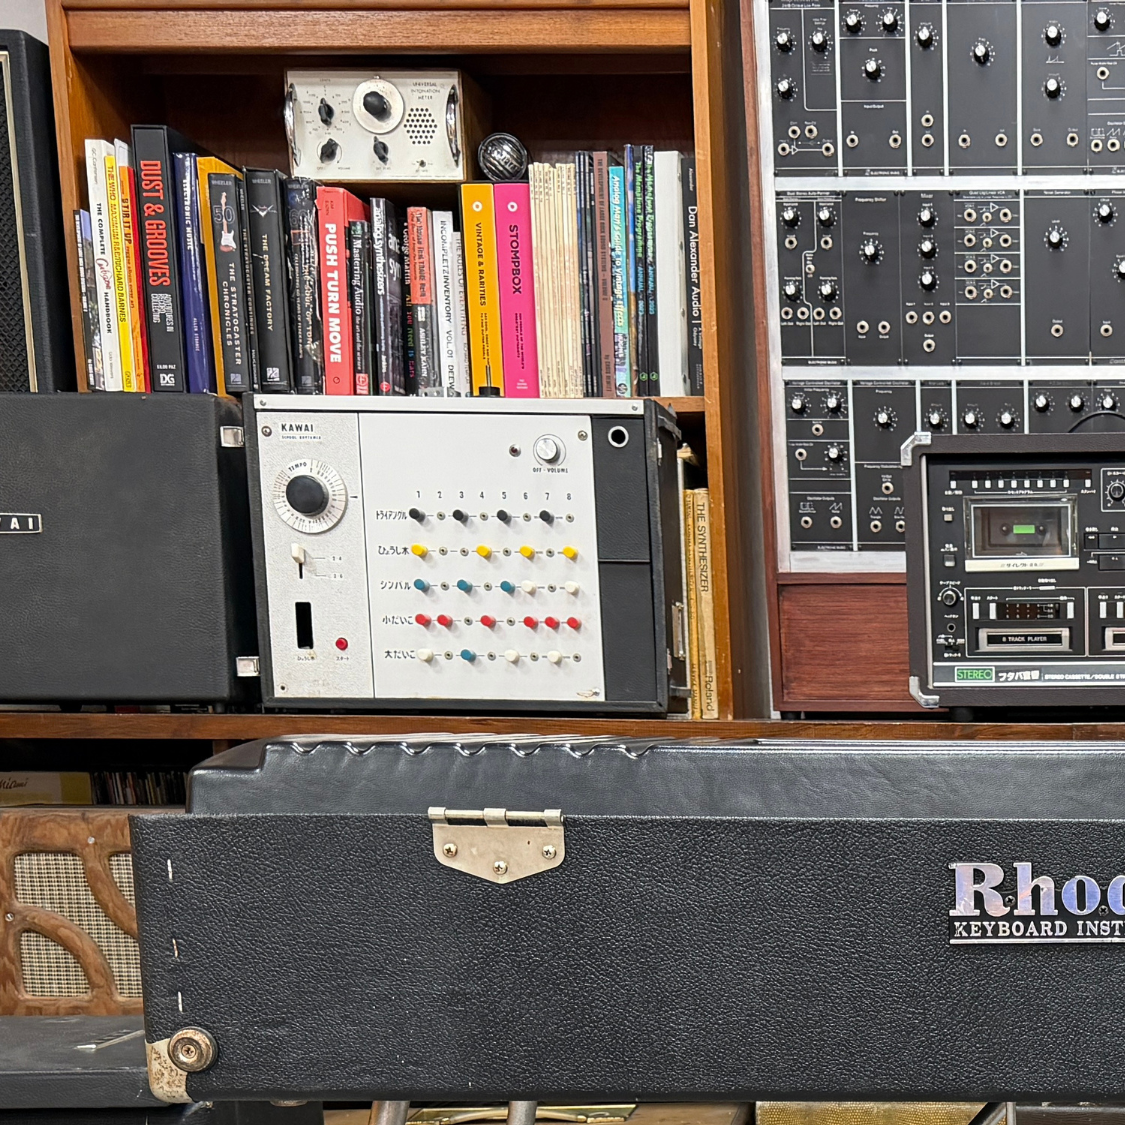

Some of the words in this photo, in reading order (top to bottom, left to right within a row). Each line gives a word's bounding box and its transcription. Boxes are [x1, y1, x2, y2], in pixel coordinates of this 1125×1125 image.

[140, 160, 164, 200] DUST
[610, 175, 621, 205] Analog
[121, 198, 130, 219] STIR
[143, 202, 164, 217] &
[212, 205, 235, 224] 50
[612, 207, 622, 230] Man's
[688, 206, 698, 228] Dan
[123, 220, 131, 229] IT
[124, 231, 132, 245] UP
[145, 220, 171, 286] GROOVES
[325, 223, 338, 267] PUSH
[475, 222, 484, 259] VINTAGE
[351, 239, 362, 285] Mastering
[375, 239, 385, 295] synthesizers
[509, 224, 522, 294] STOMPBOX
[689, 230, 701, 283] Alexander
[97, 219, 106, 255] COMPLETE
[104, 292, 112, 334] HANDBOOK
[228, 262, 236, 282] THE
[615, 268, 624, 300] Vintage
[326, 271, 340, 314] TURN
[354, 286, 364, 315] Audio
[478, 268, 487, 307] RARITIES
[691, 286, 702, 317] Audio
[118, 292, 127, 322] BARNES
[222, 281, 233, 346] CHRONICLES
[615, 301, 625, 327] Effects
[230, 286, 242, 365] STRATOCASTER
[329, 318, 342, 363] MOVE
[281, 423, 314, 433] KAWAI
[288, 461, 307, 472] TEMPO
[438, 491, 442, 499] 2
[459, 491, 464, 499] 3
[502, 492, 507, 500] 5
[523, 492, 528, 500] 6
[567, 493, 572, 501] 8
[376, 510, 408, 520] トライアングル
[696, 503, 706, 522] THE
[378, 546, 410, 556] ひょうし木
[698, 526, 709, 593] SYNTHESIZER
[380, 580, 412, 591] シンバル
[382, 616, 414, 625] 小だいこ
[384, 650, 416, 660] 大だいこ
[956, 670, 993, 680] STEREO
[704, 676, 714, 712] Roland
[954, 920, 1068, 938] KEYBOARD
